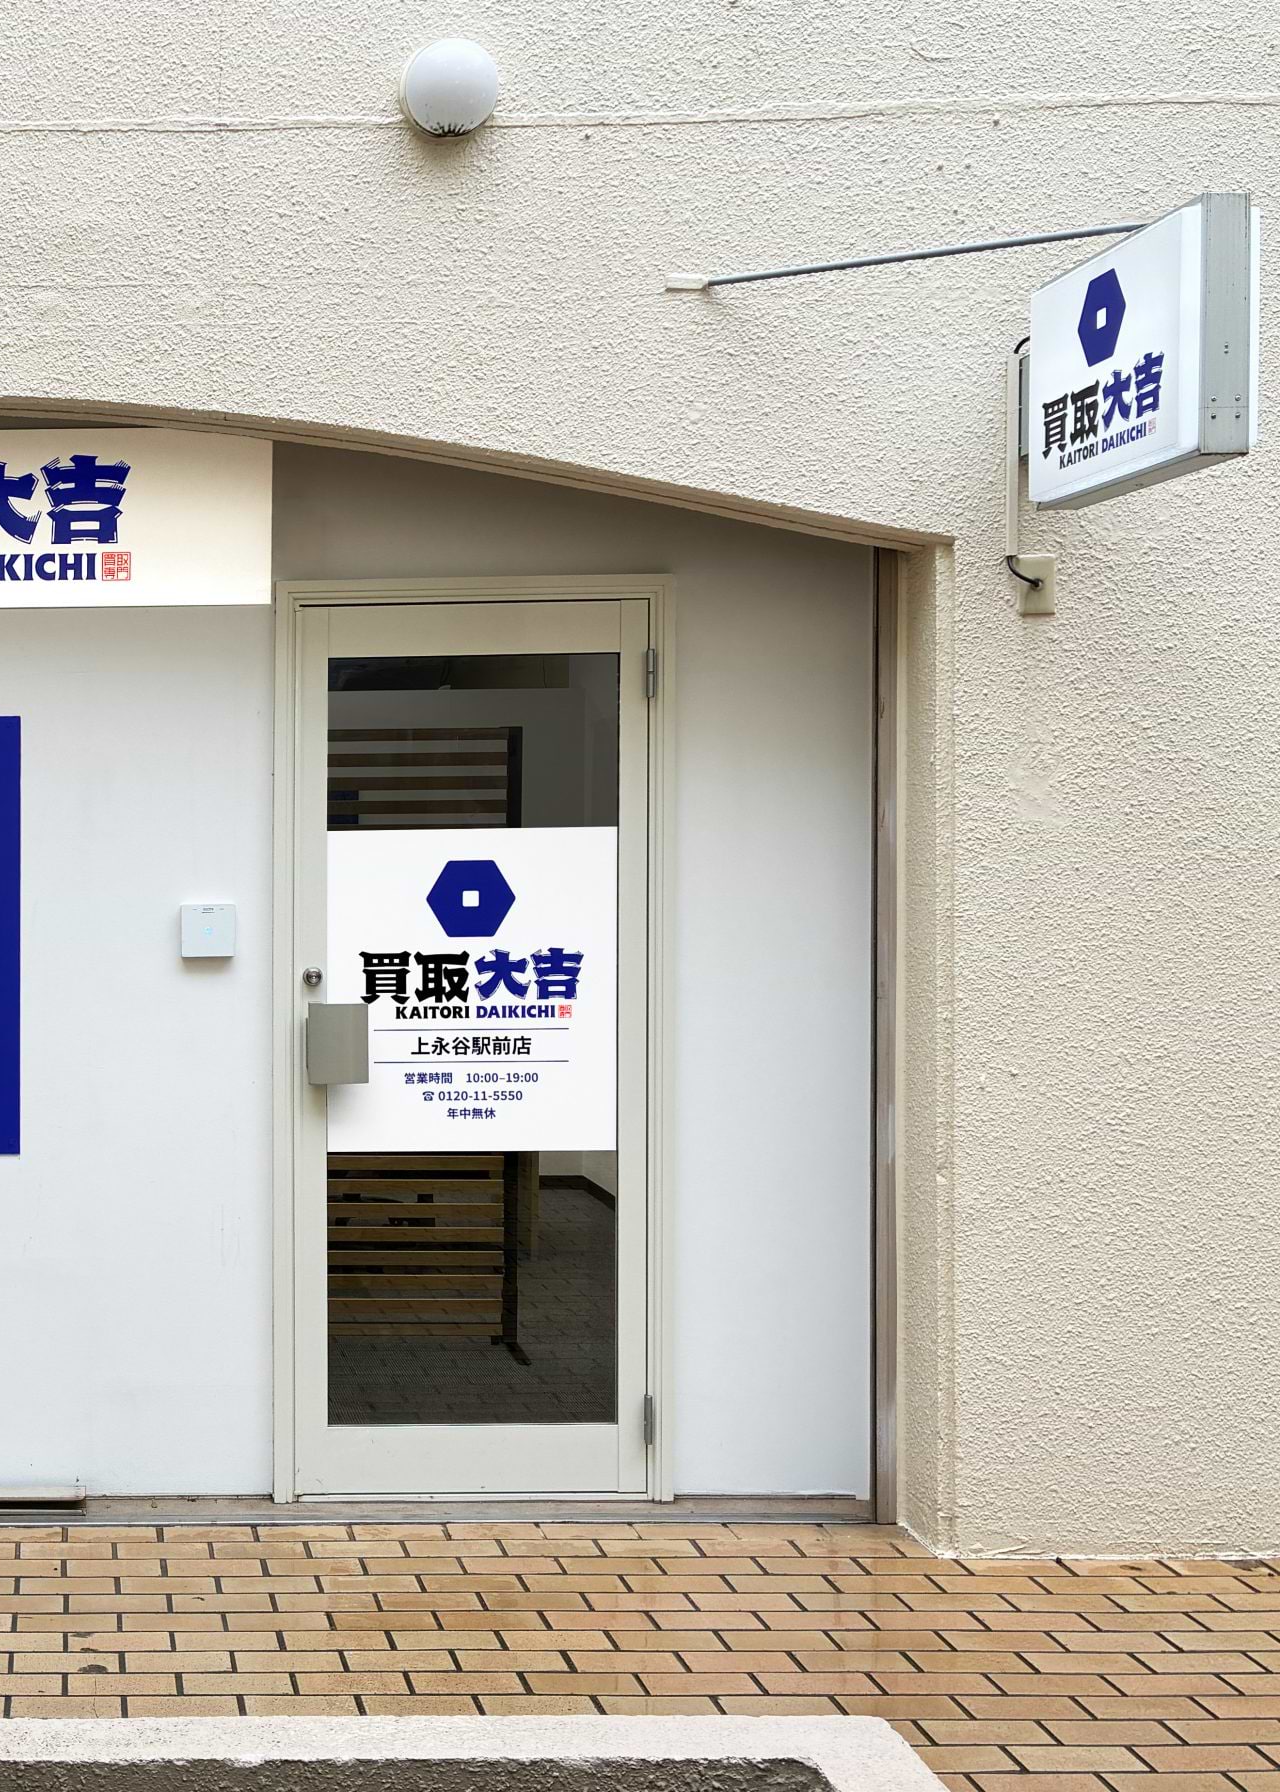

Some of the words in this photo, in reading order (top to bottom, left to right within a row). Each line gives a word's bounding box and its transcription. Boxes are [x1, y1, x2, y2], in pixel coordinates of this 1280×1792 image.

[1042, 351, 1165, 459] 買取大吉
[1059, 440, 1099, 469] KAITORI
[1102, 421, 1147, 454] DAIKICHI
[359, 948, 584, 1004] 買取大吉
[395, 1005, 471, 1020] KAITORI
[475, 1004, 556, 1019] DAIKICHI
[411, 1036, 531, 1055] 上永谷駅前店
[403, 1071, 453, 1085] 営業時間
[437, 1090, 523, 1102] 0120-11-5550
[446, 1106, 497, 1120] 年中無休
